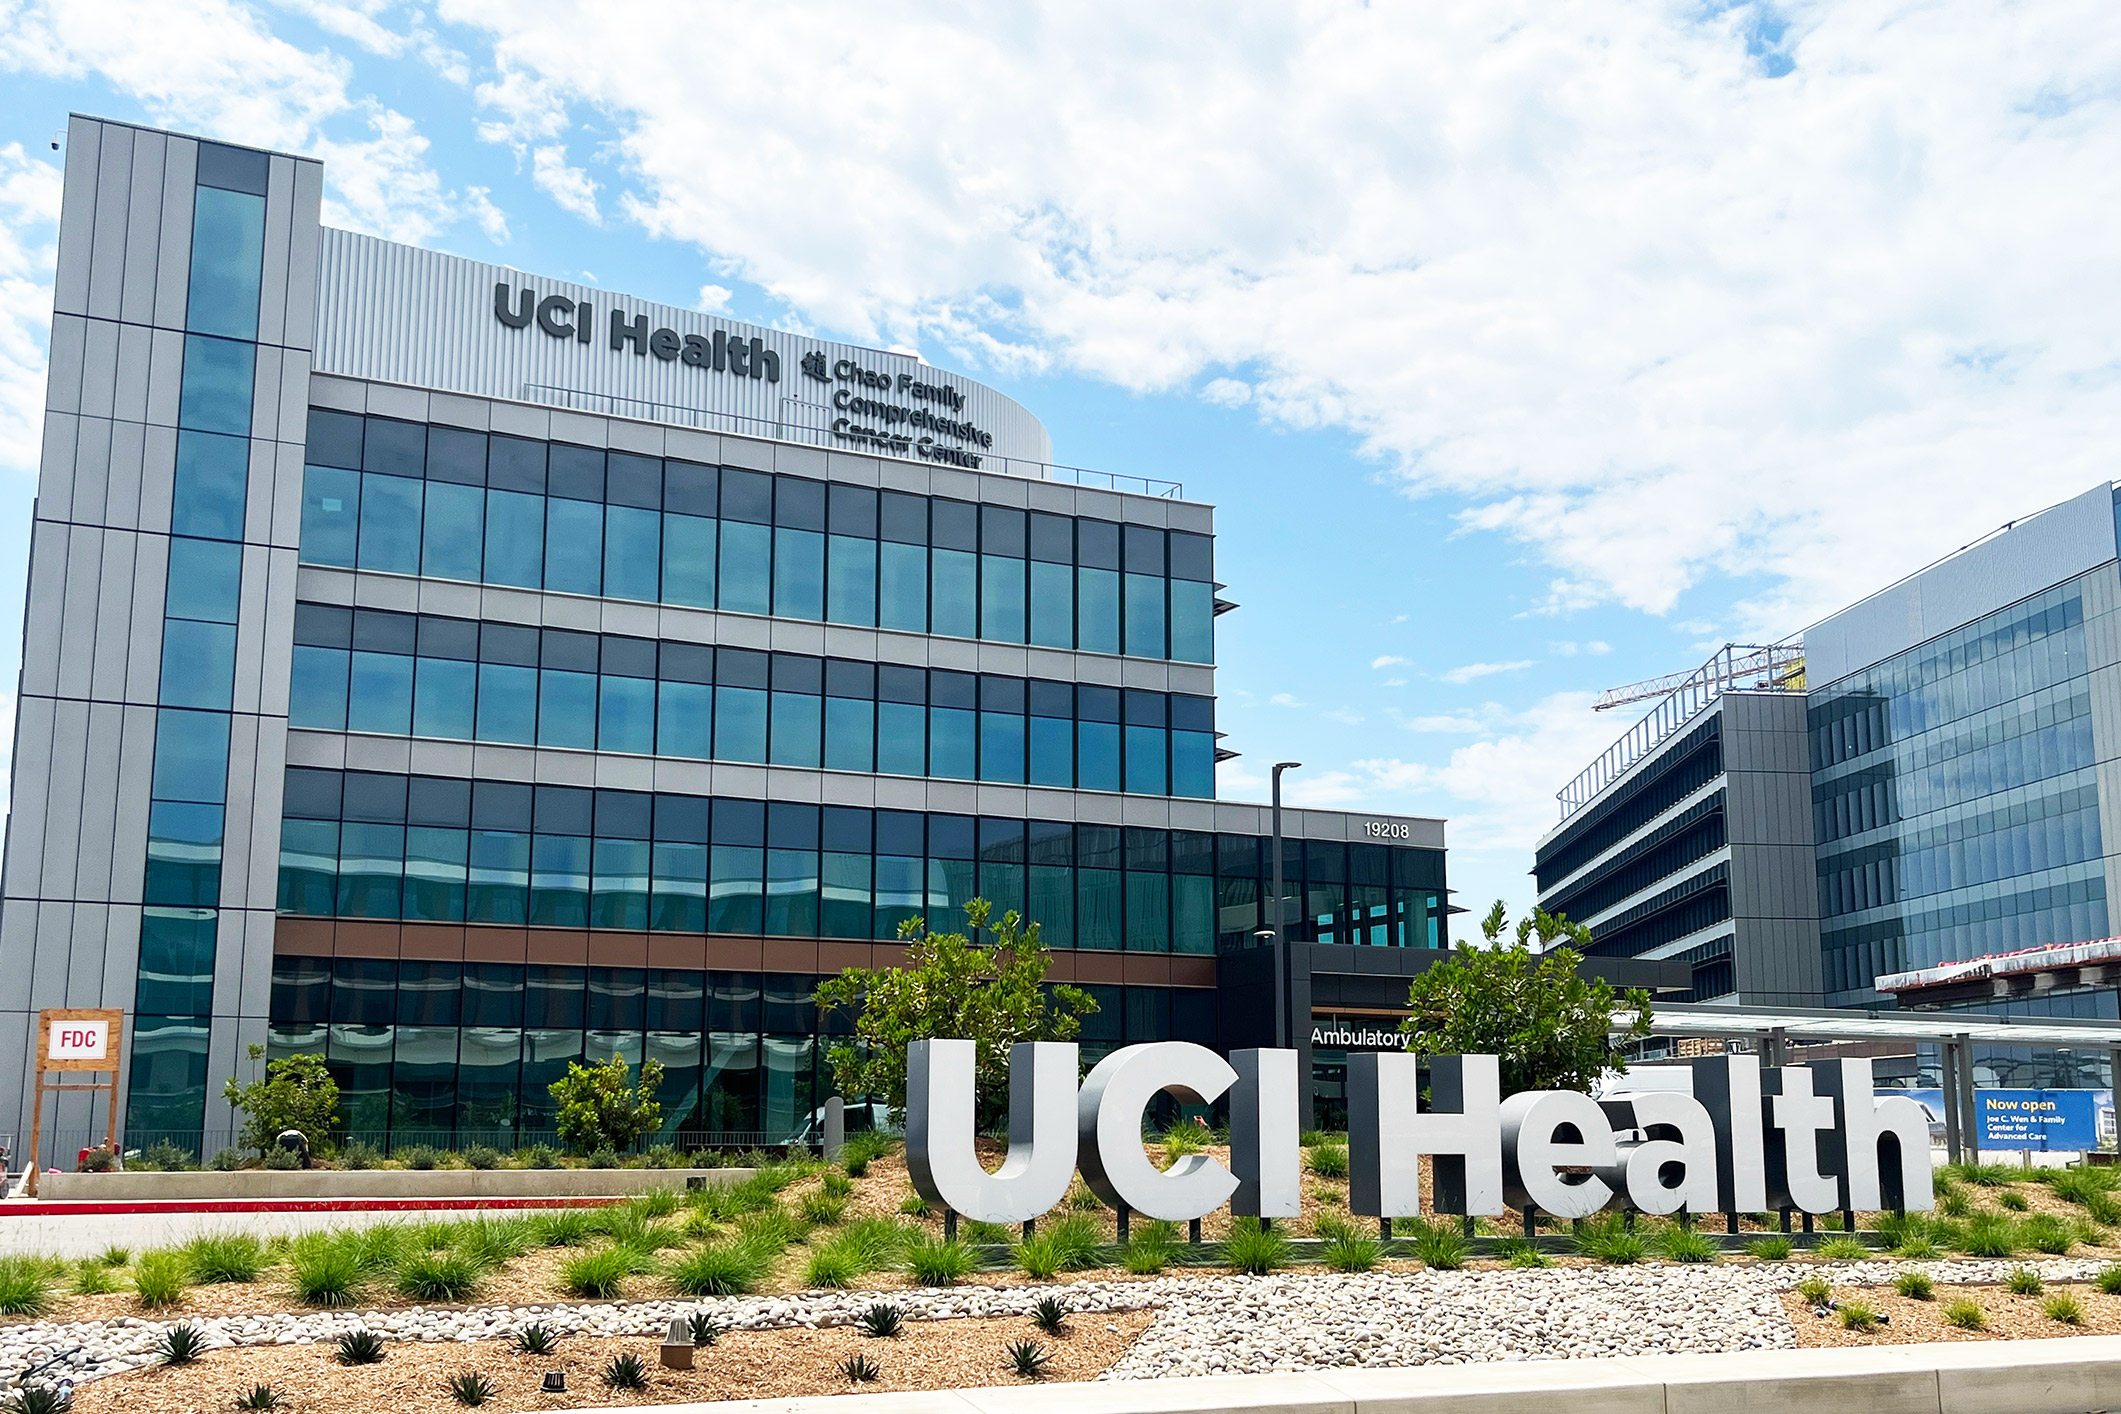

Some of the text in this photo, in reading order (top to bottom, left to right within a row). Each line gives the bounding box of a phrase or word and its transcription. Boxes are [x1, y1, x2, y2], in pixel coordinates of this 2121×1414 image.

[495, 282, 780, 383] UCI Health
[834, 359, 967, 413] Chao Family
[833, 389, 993, 450] Comprehensive
[833, 417, 983, 470] Cancer Center
[1364, 821, 1410, 839] 19208
[60, 1030, 97, 1048] FDC
[1311, 1027, 1411, 1050] Ambulatory
[1986, 1099, 2056, 1113] Now open
[905, 1038, 1935, 1224] UCI Health
[1987, 1115, 1999, 1123] Joe
[2001, 1115, 2009, 1123] C.
[2038, 1116, 2066, 1125] Family
[1988, 1132, 2047, 1140] Advanced Care
